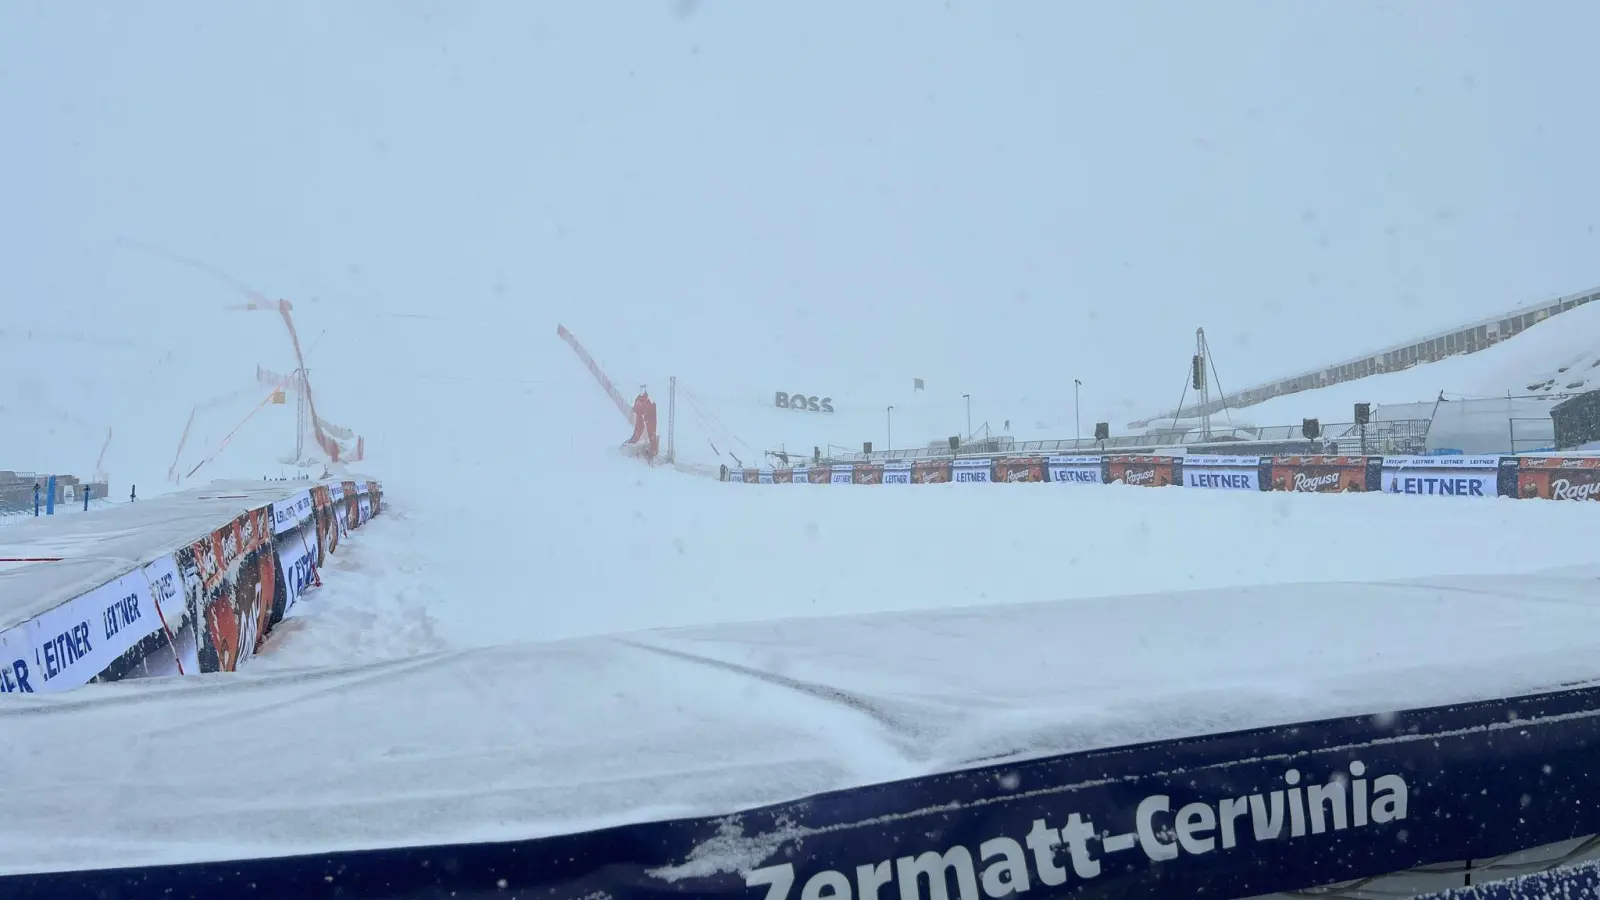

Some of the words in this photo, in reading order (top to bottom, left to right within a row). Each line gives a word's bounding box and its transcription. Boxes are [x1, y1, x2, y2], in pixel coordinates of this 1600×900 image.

[775, 391, 834, 413] BOSS
[885, 474, 908, 484] LEITNER
[956, 472, 987, 482] LEITNER
[1054, 470, 1097, 482] LEITNER
[1125, 469, 1155, 484] Ragusa
[1191, 473, 1250, 489] LEITNER
[1294, 472, 1341, 491] Ragusa
[1392, 477, 1484, 497] LEITNER
[103, 593, 142, 641] LEITNER
